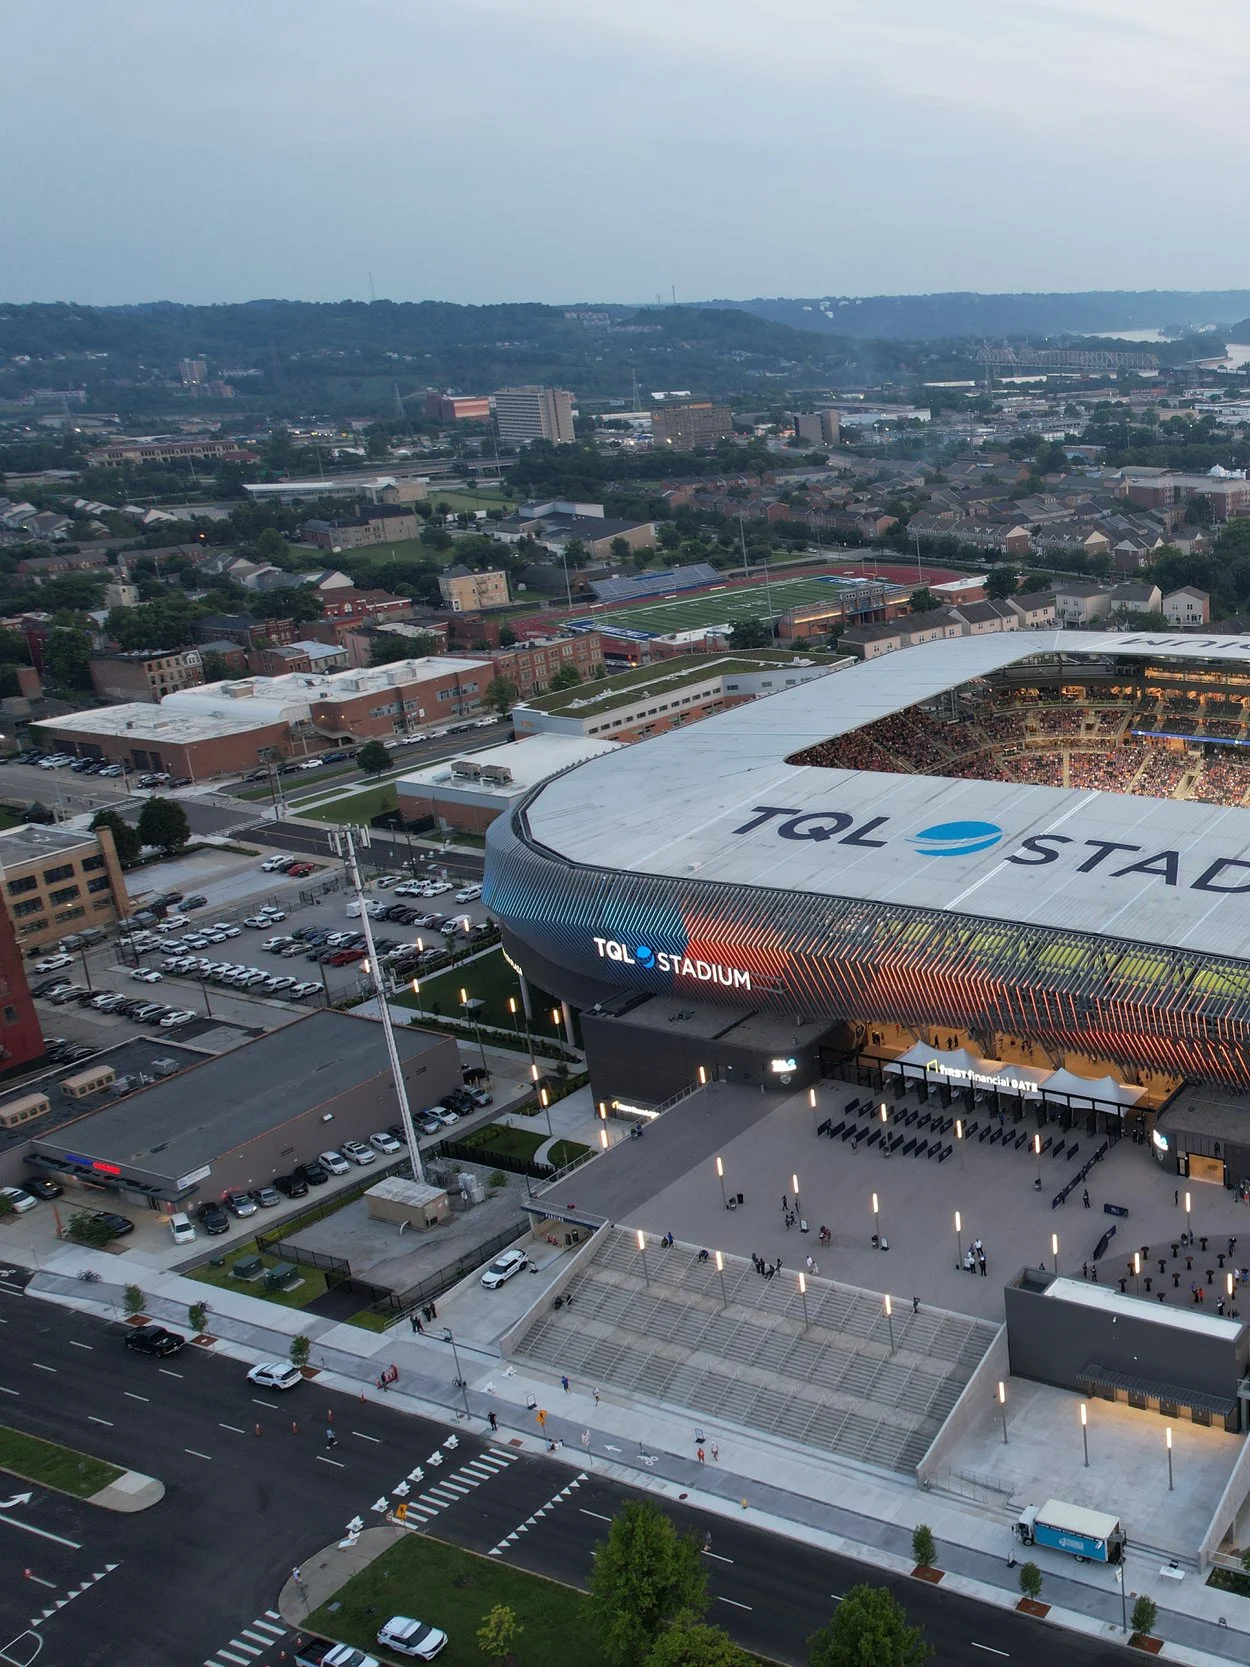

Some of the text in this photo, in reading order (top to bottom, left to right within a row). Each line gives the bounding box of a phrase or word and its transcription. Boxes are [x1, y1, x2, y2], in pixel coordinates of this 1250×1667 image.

[731, 806, 891, 848] TQL
[593, 937, 752, 991] TQL STADIUM
[1010, 1079, 1038, 1092] GATE
